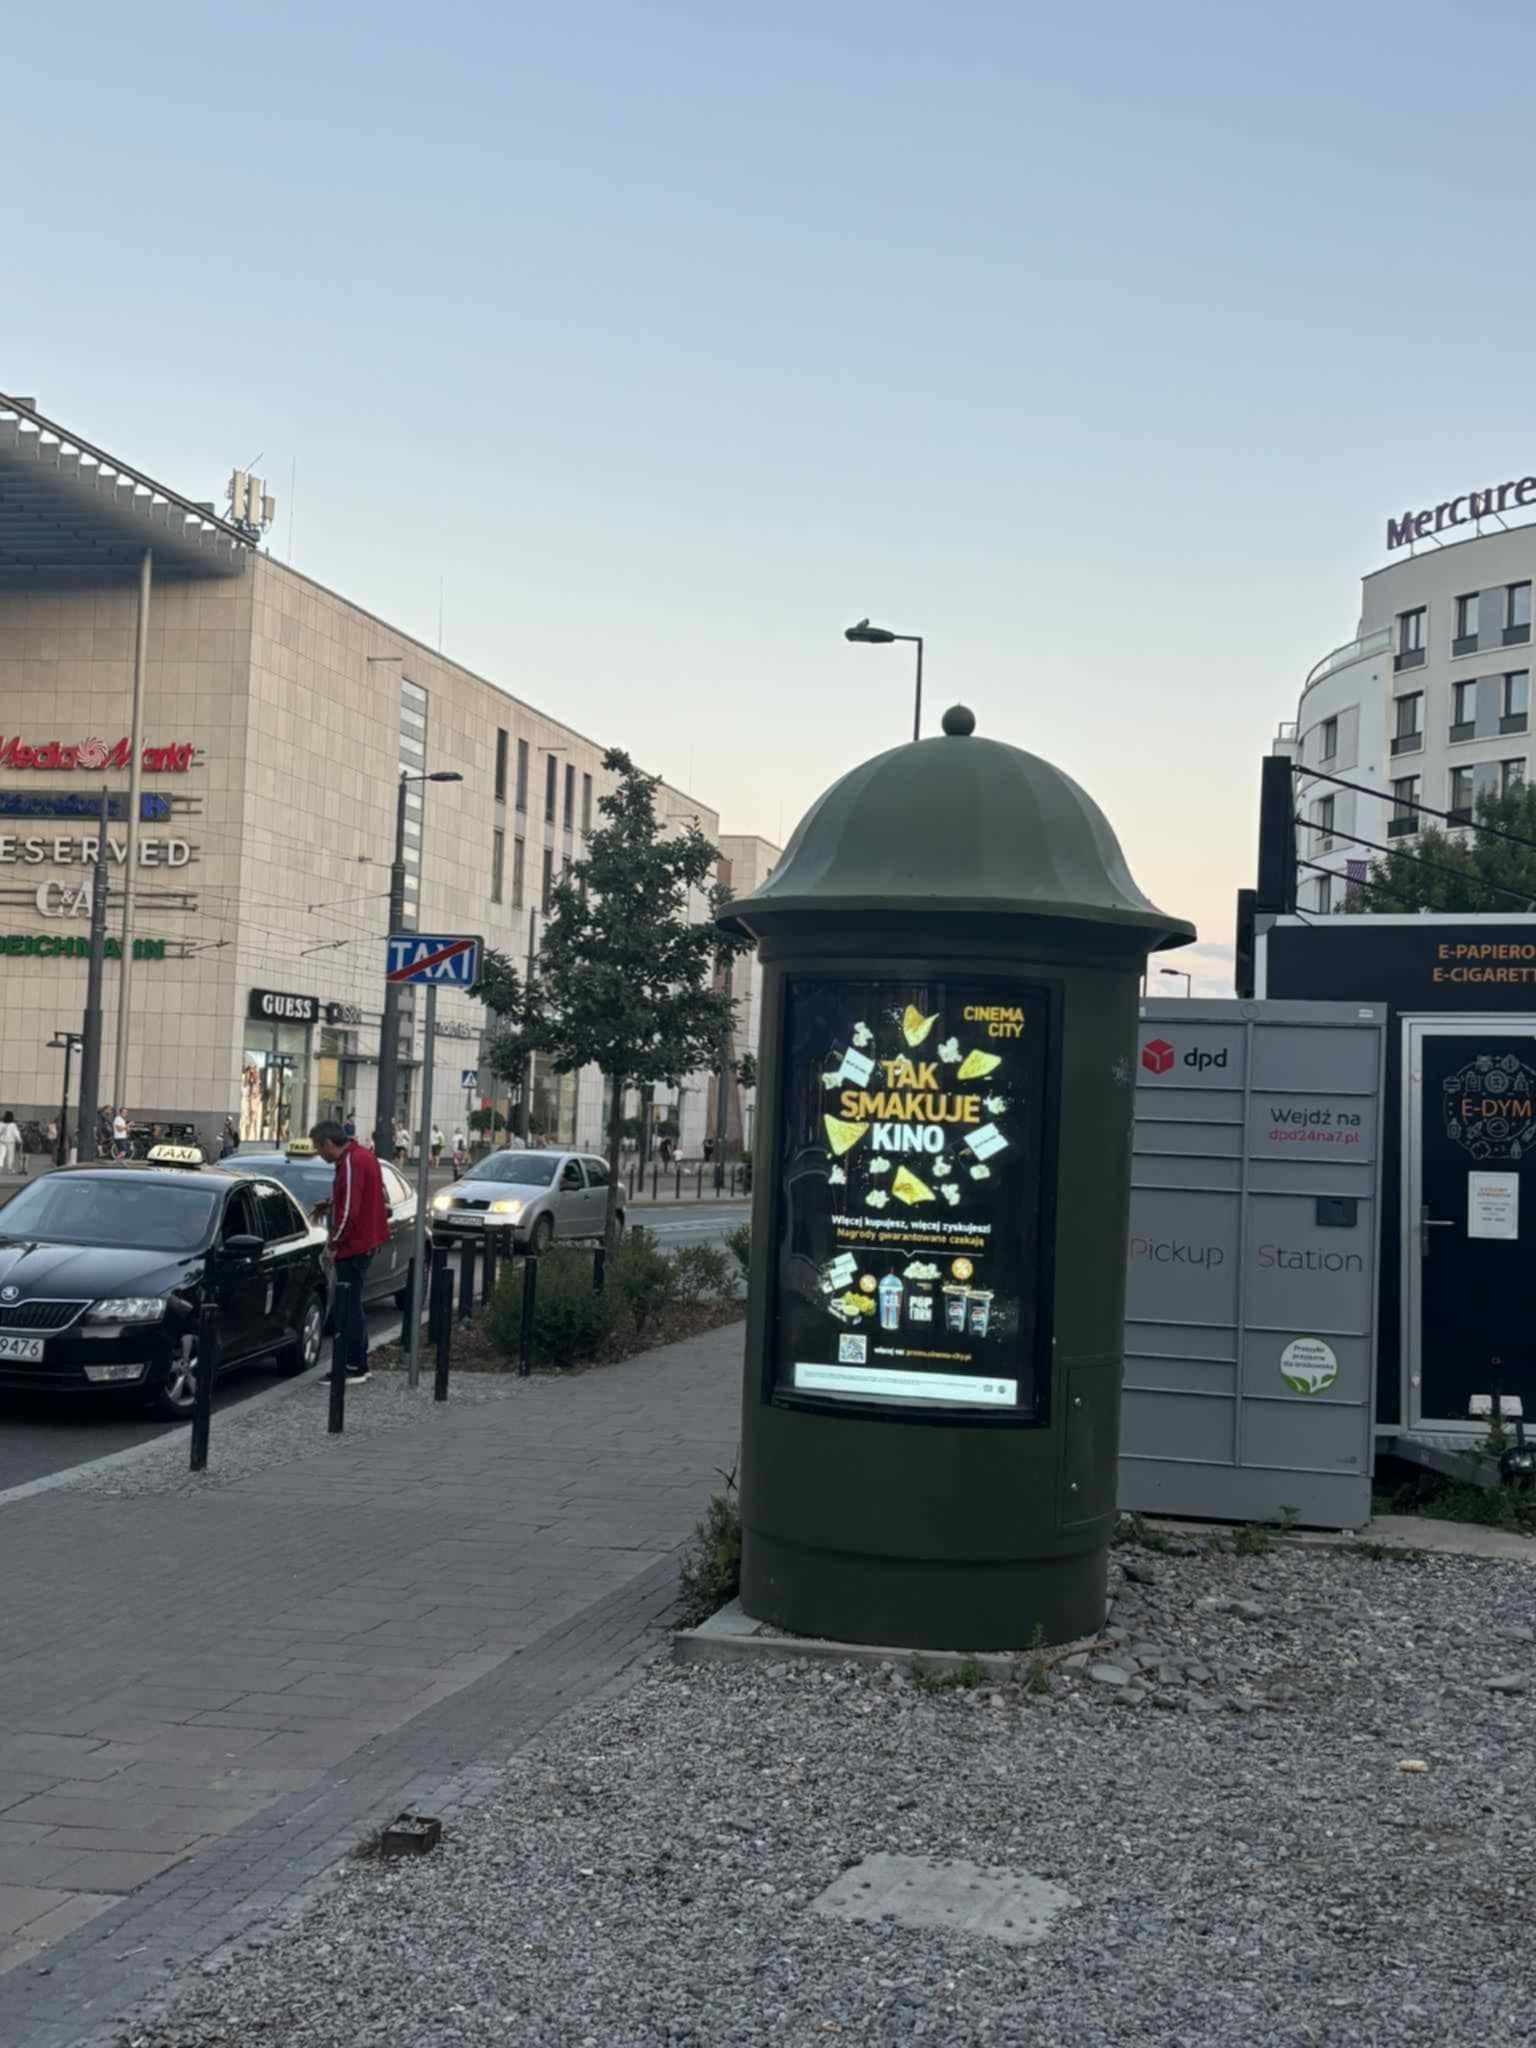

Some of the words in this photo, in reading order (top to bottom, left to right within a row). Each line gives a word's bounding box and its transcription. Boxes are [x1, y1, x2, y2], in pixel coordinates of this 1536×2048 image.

[1387, 476, 1536, 551] Mercure
[36, 880, 94, 918] C&A
[391, 942, 470, 979] TAXI
[1438, 944, 1536, 960] E-PAPIERO
[262, 994, 312, 1019] GUESS
[964, 1006, 1024, 1022] CINEMA
[988, 1023, 1024, 1038] CITY
[1184, 1047, 1228, 1072] dpd
[881, 1060, 939, 1090] TAK
[840, 1090, 981, 1124] SMAKUJE
[1462, 1099, 1531, 1117] E-DYM
[1337, 1113, 1361, 1127] na
[872, 1122, 944, 1153] KINO
[1269, 1128, 1360, 1145] dpd24na7.pl
[155, 1147, 194, 1160] TAXI
[831, 1214, 863, 1227] Więcej
[837, 1228, 876, 1241] Nagrody
[1130, 1237, 1224, 1270] Pickup
[1258, 1244, 1363, 1272] Station
[0, 1338, 39, 1357] 9476
